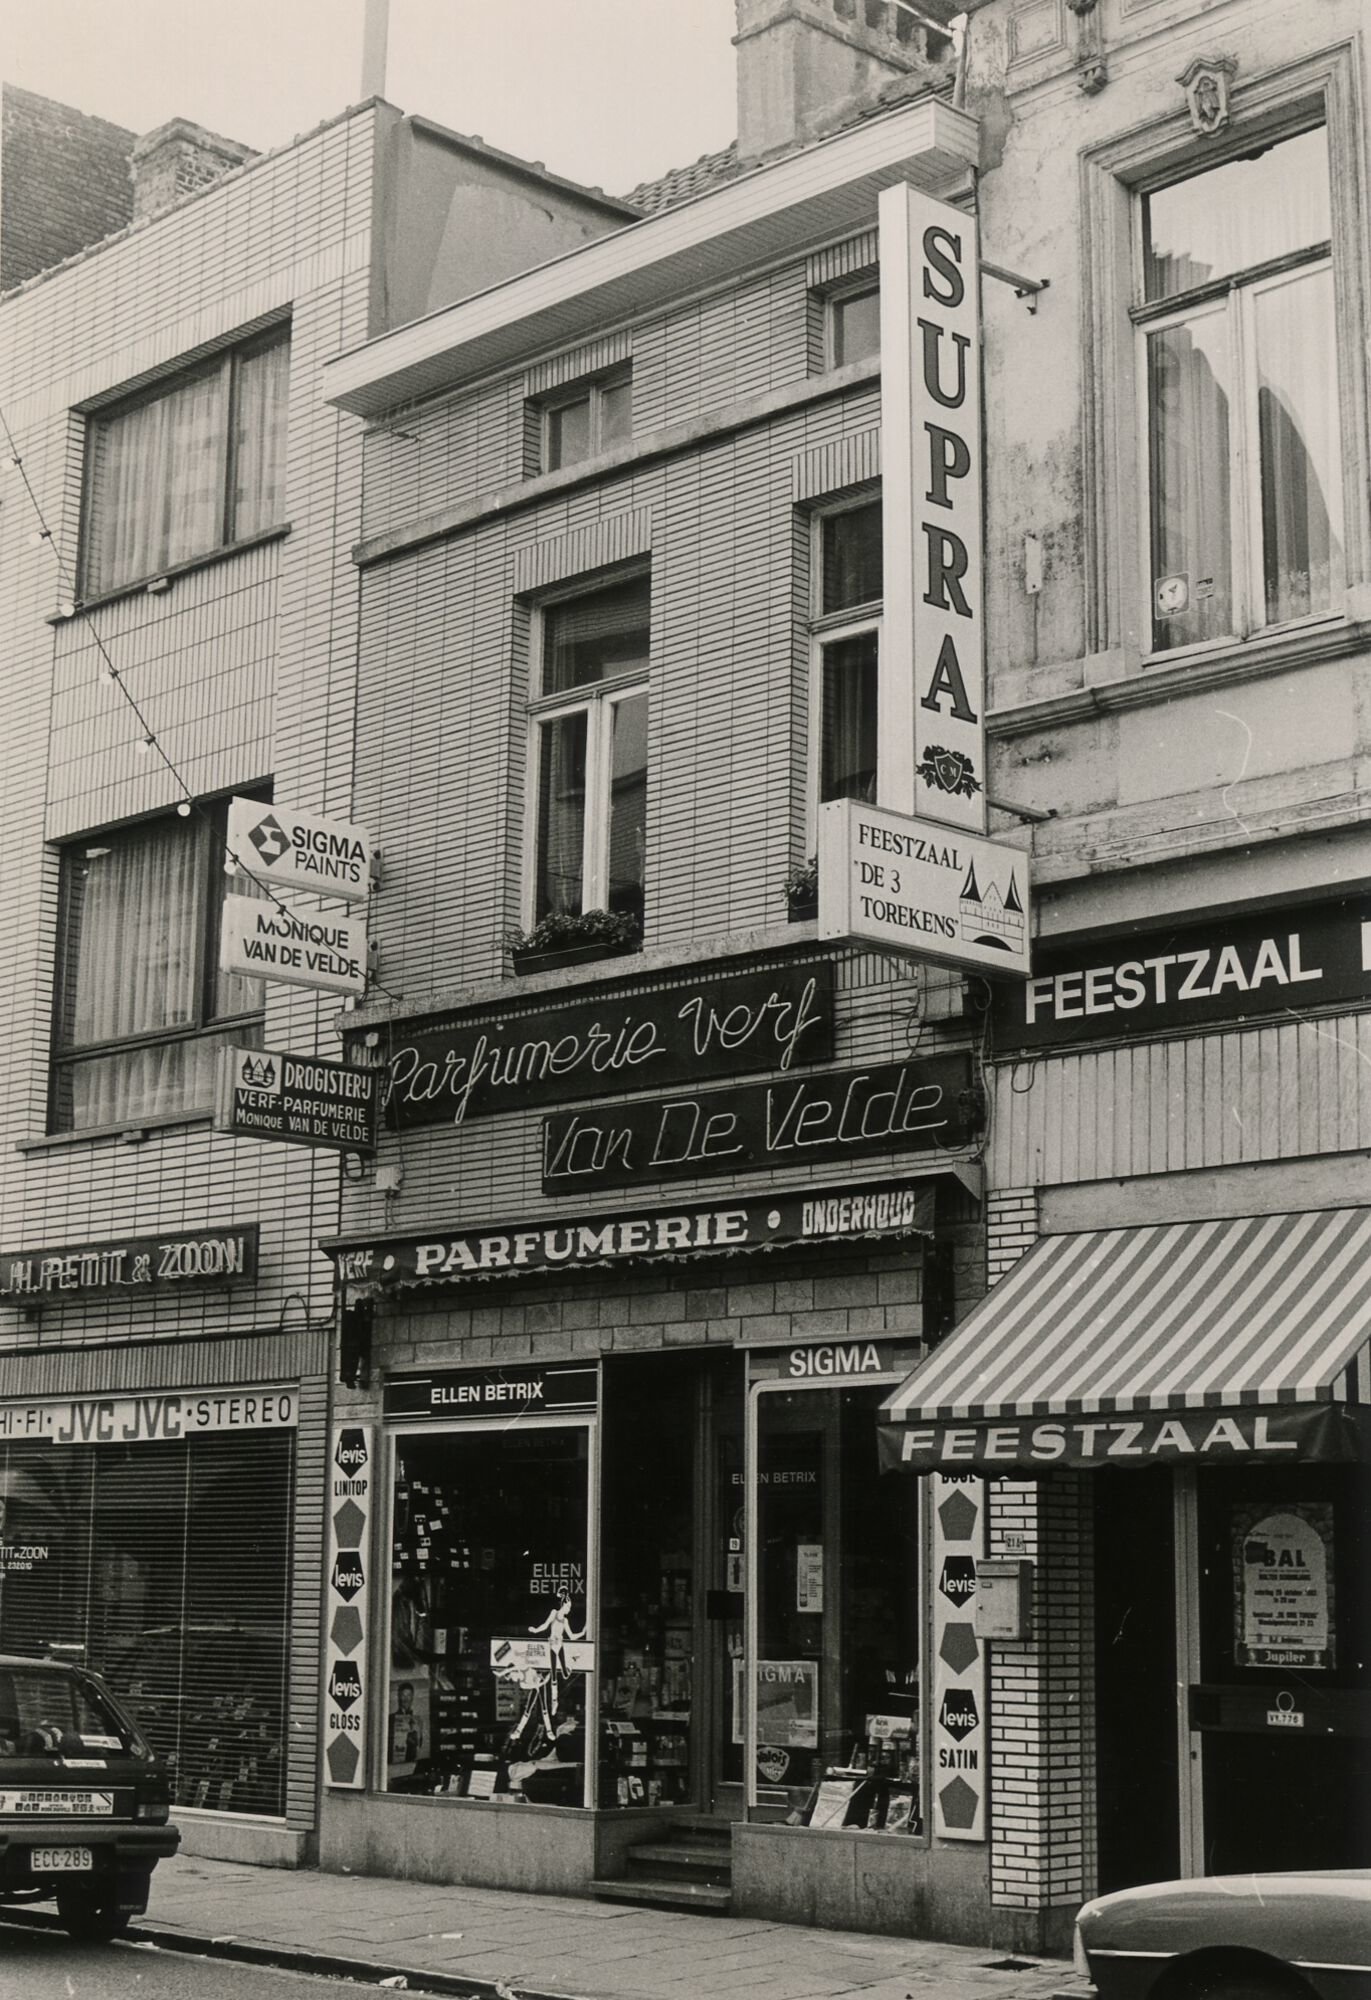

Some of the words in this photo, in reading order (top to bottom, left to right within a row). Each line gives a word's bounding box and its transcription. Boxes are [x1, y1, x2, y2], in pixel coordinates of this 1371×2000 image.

[917, 226, 978, 724] SUPRA
[292, 825, 366, 863] SIGMA
[859, 824, 962, 871] FEESTZAAL
[295, 852, 360, 882] PAINTS
[891, 870, 900, 894] 3
[257, 914, 348, 950] MONIQUE
[243, 938, 276, 964] VAN
[280, 948, 302, 968] DE
[306, 951, 359, 978] VELDE
[1026, 933, 1322, 1025] FEESTZAAL
[382, 1017, 666, 1124] Parfumerie
[289, 1112, 310, 1132] VAN
[314, 1118, 328, 1136] DE
[331, 1120, 369, 1142] VELDE
[544, 1117, 632, 1177] Van
[649, 1102, 743, 1165] De
[767, 1068, 948, 1150] Velde
[133, 1254, 152, 1282] &
[158, 1238, 244, 1278] ZOON
[337, 1249, 374, 1280] VERF
[416, 1210, 748, 1275] PARFUMERIE
[789, 1344, 881, 1377] SIGMA
[431, 1386, 480, 1405] ELLEN
[485, 1382, 544, 1402] BETRIX
[58, 1403, 114, 1442] JVC
[122, 1398, 181, 1438] JVC
[196, 1396, 291, 1426] STEREO
[901, 1416, 1298, 1462] FEESTZAAL
[334, 1480, 368, 1496] LINITOP
[773, 1472, 816, 1484] BETRIX
[19, 1546, 48, 1560] ZOON
[1264, 1550, 1306, 1567] BAL
[533, 1563, 582, 1578] ELLEN
[530, 1580, 584, 1594] BETRIX
[1265, 1651, 1306, 1664] Jupiler
[758, 1666, 806, 1683] IGMA
[330, 1714, 360, 1731] GLOSS
[939, 1749, 978, 1770] SATIN
